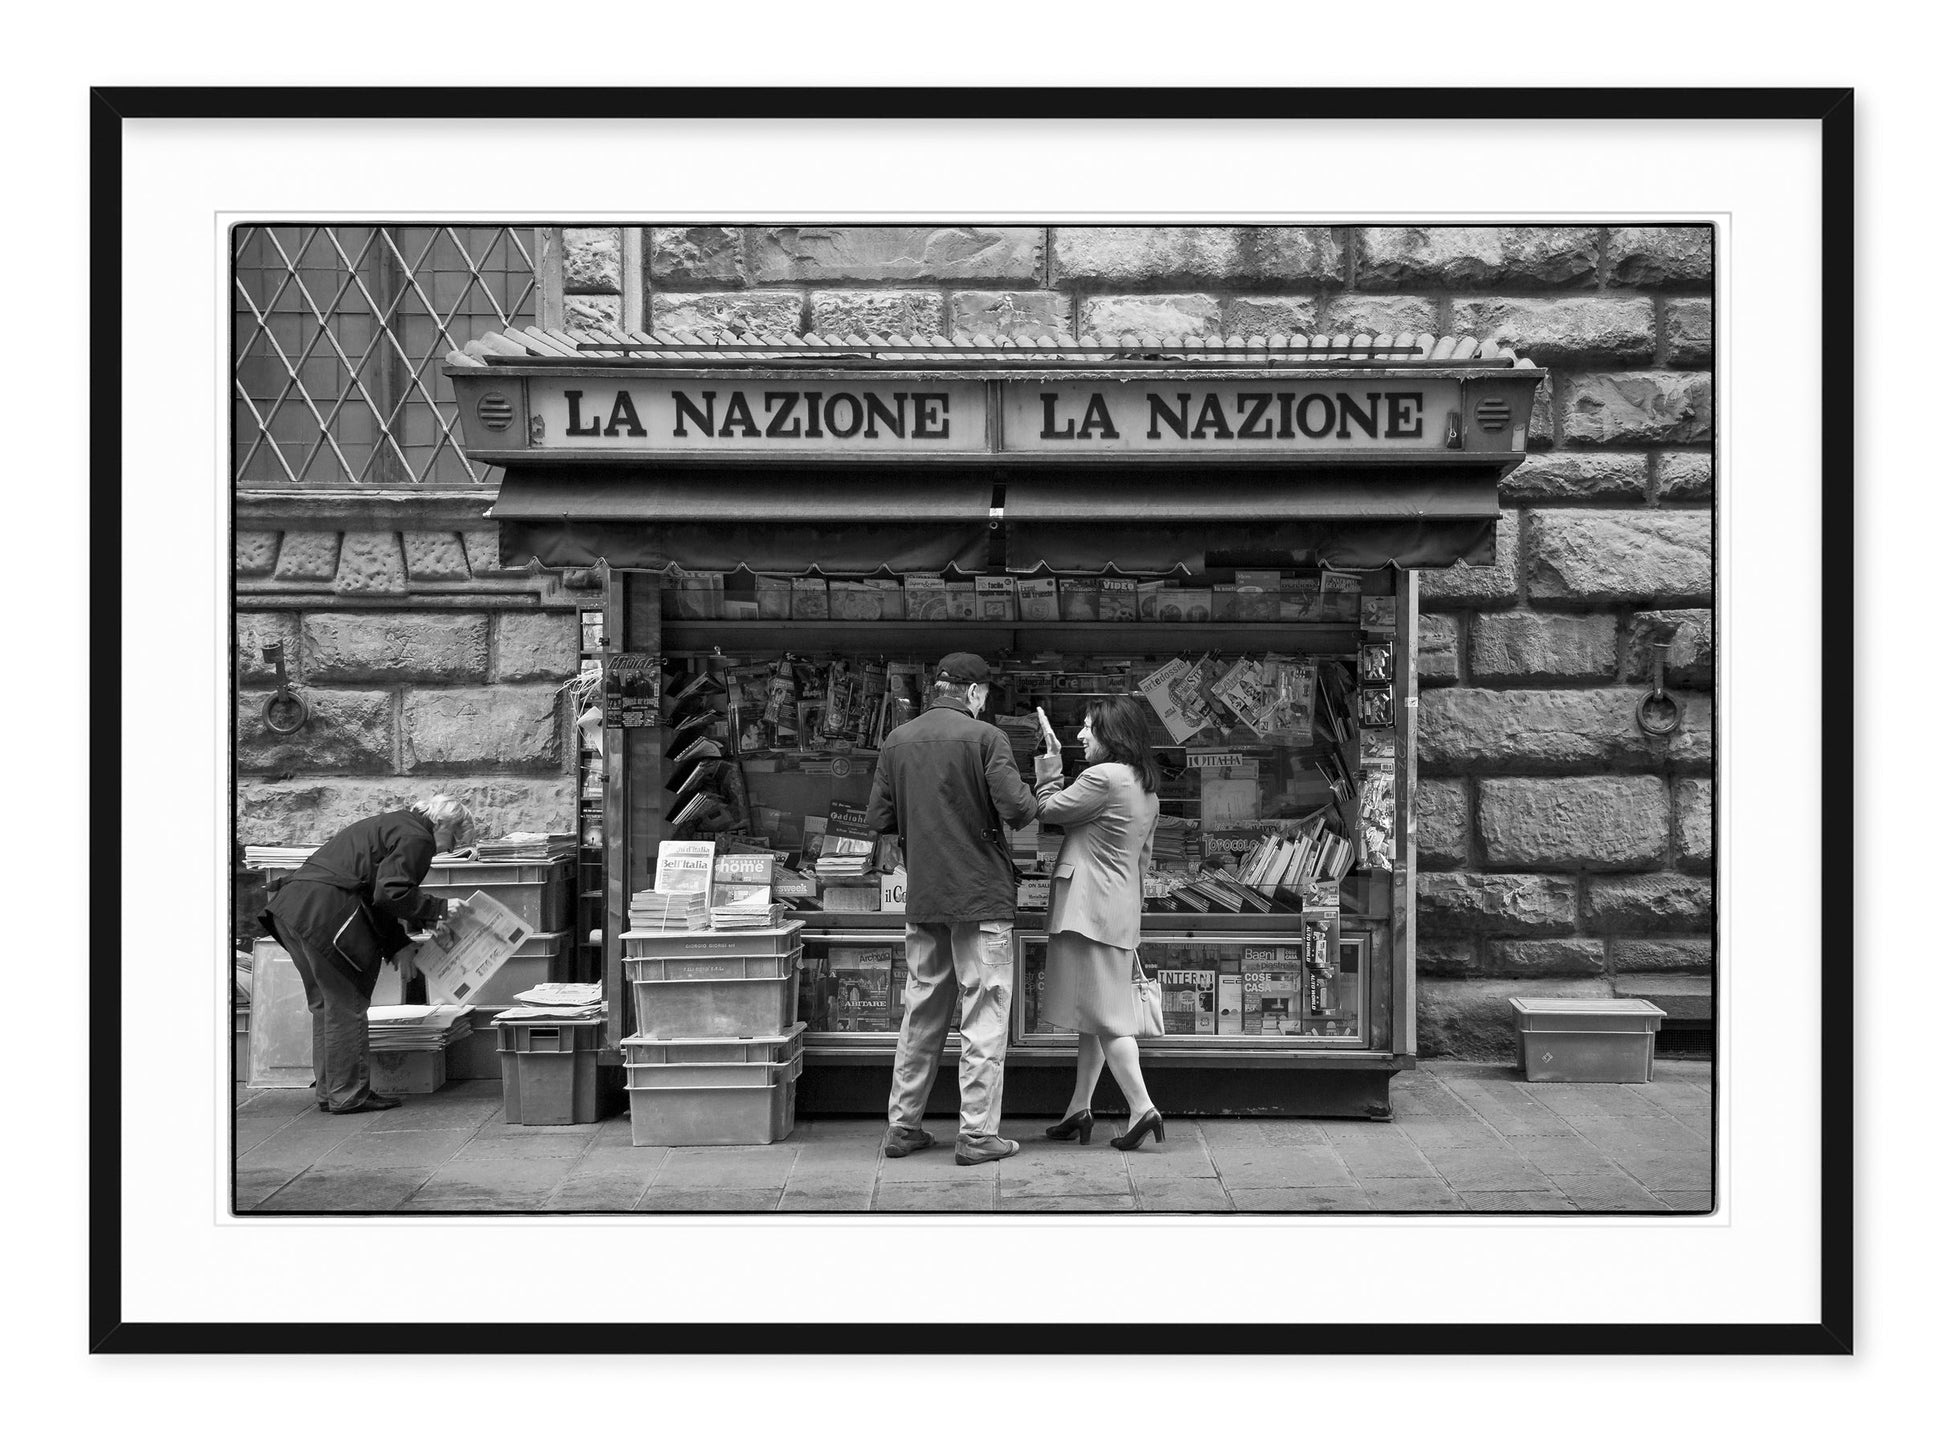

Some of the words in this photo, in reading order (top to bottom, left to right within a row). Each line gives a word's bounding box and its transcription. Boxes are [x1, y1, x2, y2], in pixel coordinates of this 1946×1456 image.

[565, 390, 648, 437] LA
[672, 390, 949, 439] NAZIONE
[1040, 392, 1120, 440] LA
[1147, 392, 1423, 440] NAZIONE
[1103, 581, 1134, 590] VIDEO
[1207, 755, 1241, 766] ITALIA
[885, 889, 892, 903] il
[1245, 948, 1275, 961] Bagni
[1159, 972, 1213, 985] INTERNI
[1244, 972, 1272, 982] COSE
[1244, 982, 1272, 992] CASA
[844, 999, 887, 1007] ABITARE
